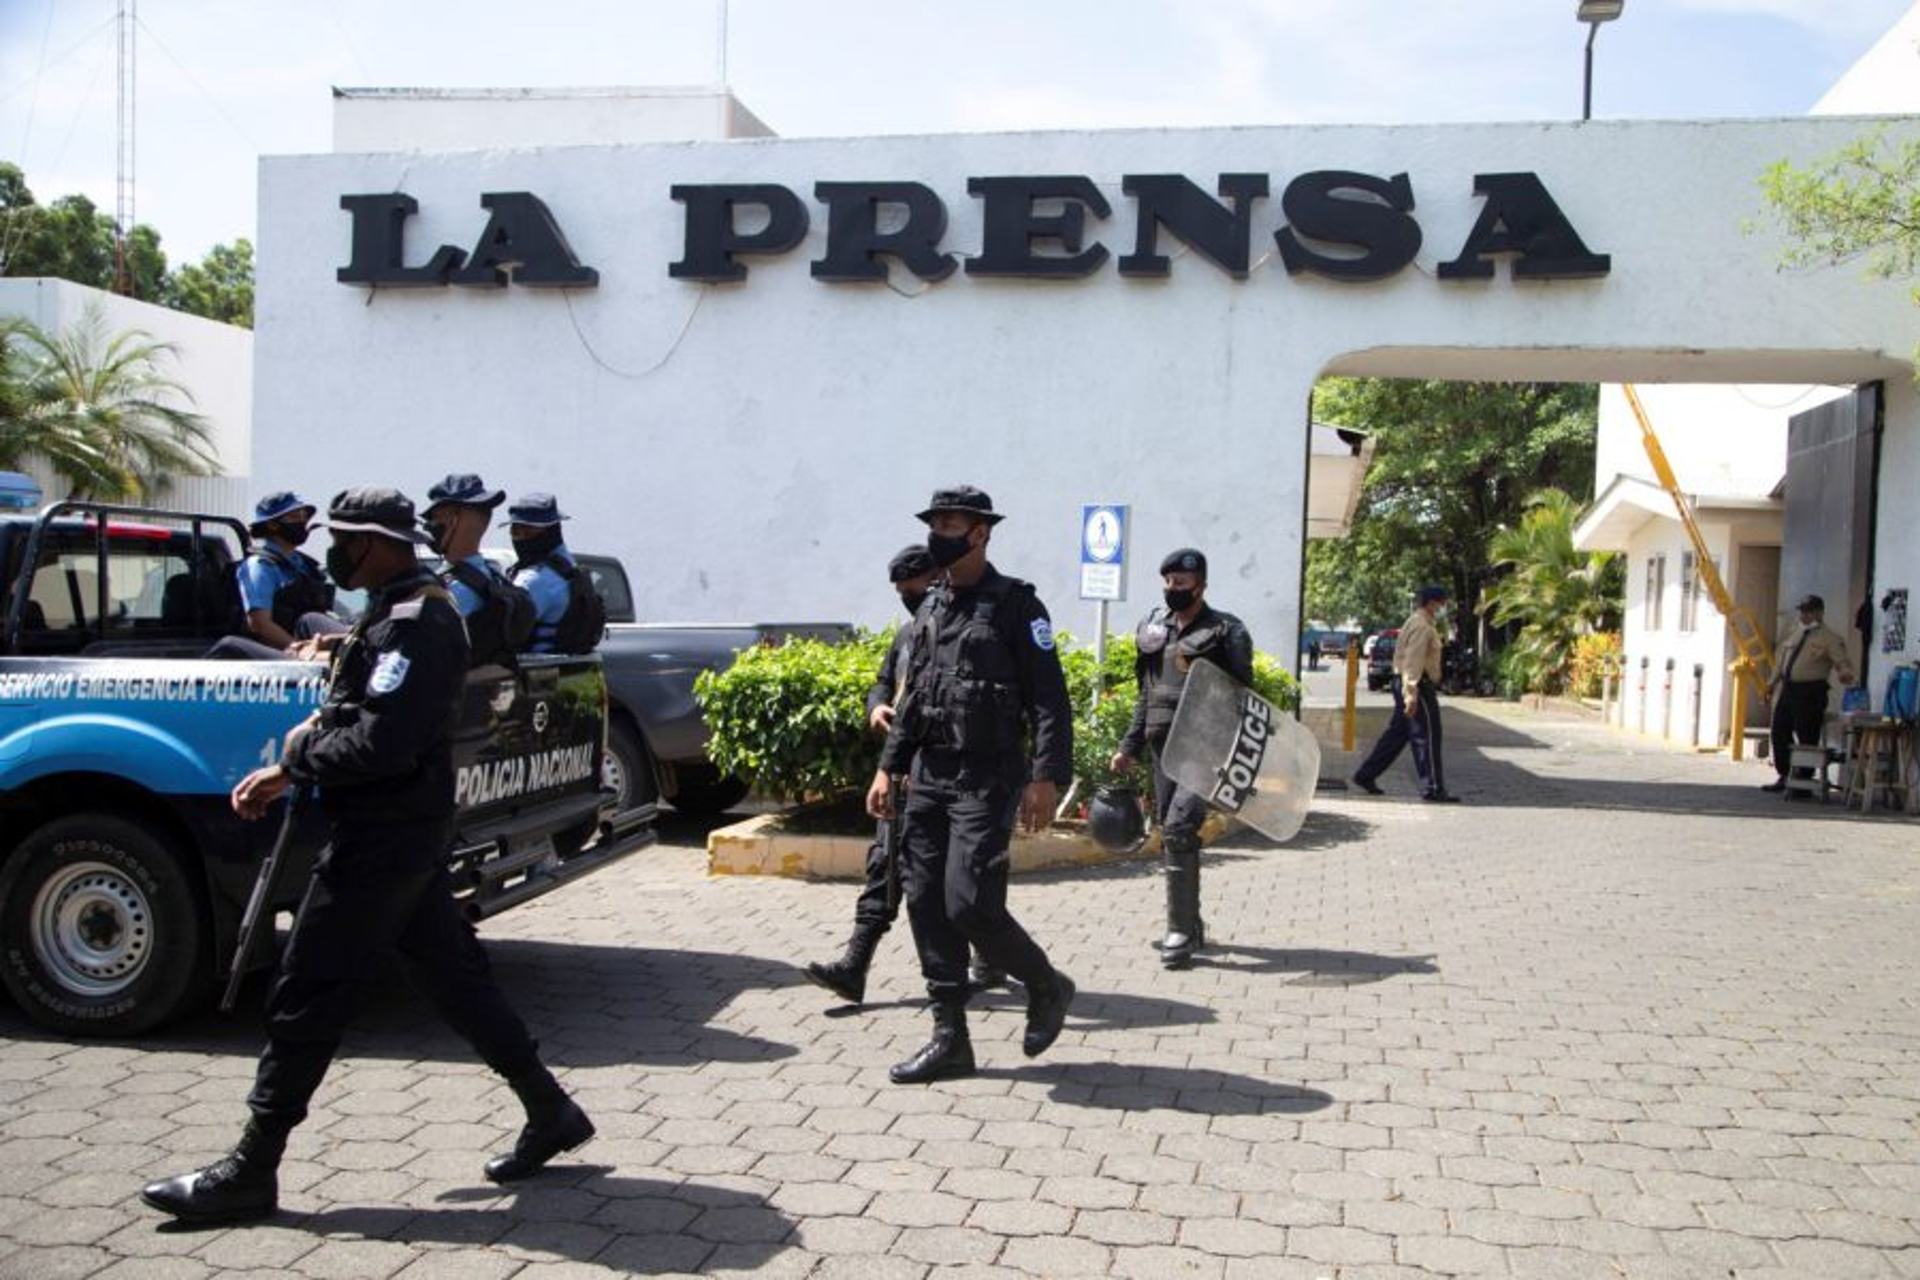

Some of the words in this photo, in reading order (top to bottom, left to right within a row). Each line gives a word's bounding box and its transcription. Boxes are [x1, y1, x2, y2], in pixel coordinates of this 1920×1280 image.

[337, 191, 599, 288] LA
[668, 170, 1611, 284] PRENSA
[76, 673, 197, 701] EMERGENCIA
[202, 674, 289, 704] POLICIAL
[454, 755, 526, 806] POLICIA
[526, 741, 595, 793] NACIONAL
[1217, 695, 1269, 809] POLICE
